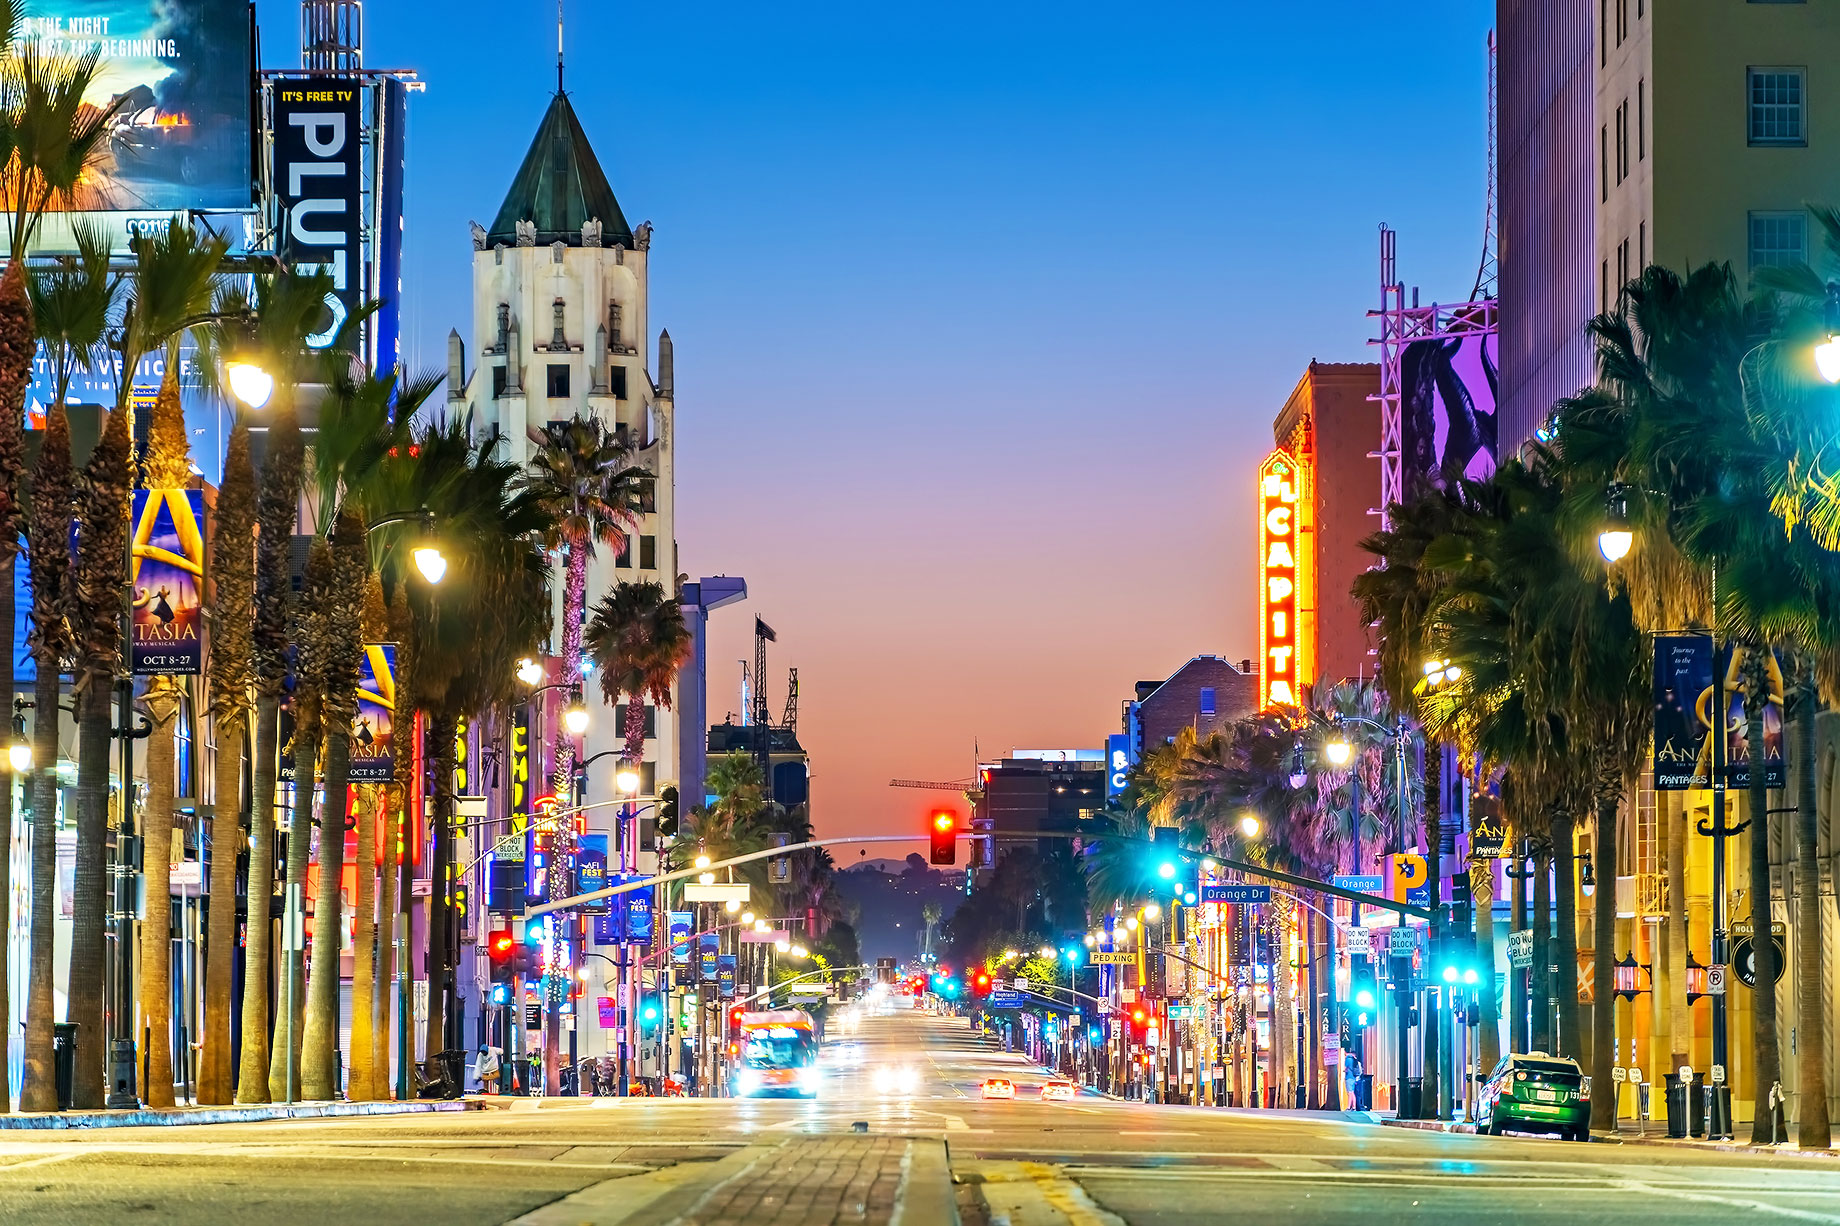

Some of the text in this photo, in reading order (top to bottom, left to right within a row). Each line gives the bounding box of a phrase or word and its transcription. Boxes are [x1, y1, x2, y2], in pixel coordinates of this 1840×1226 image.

[38, 18, 62, 34] THE
[69, 18, 109, 34] NIGHT
[70, 40, 98, 57] THE
[101, 39, 181, 58] BEGINNING.
[282, 91, 352, 101] IT'S FREE TV
[143, 655, 191, 665] OCT 8-27
[349, 768, 387, 776] OCT 8-27
[1658, 774, 1708, 785] PANTAGES
[500, 844, 520, 852] BLOCK
[587, 861, 600, 869] AFI
[582, 869, 603, 877] FEST
[1341, 879, 1375, 890] Orange
[1207, 889, 1265, 901] Orange Dr
[635, 898, 646, 906] AFI
[1408, 898, 1429, 906] Parking
[630, 904, 648, 912] FEST
[1735, 924, 1782, 933] HOLLOD
[1392, 931, 1401, 939] DO
[1511, 936, 1520, 946] DO
[1512, 946, 1533, 957] BLOC
[1093, 954, 1133, 963] PED XING
[1342, 1008, 1350, 1041] ZARA
